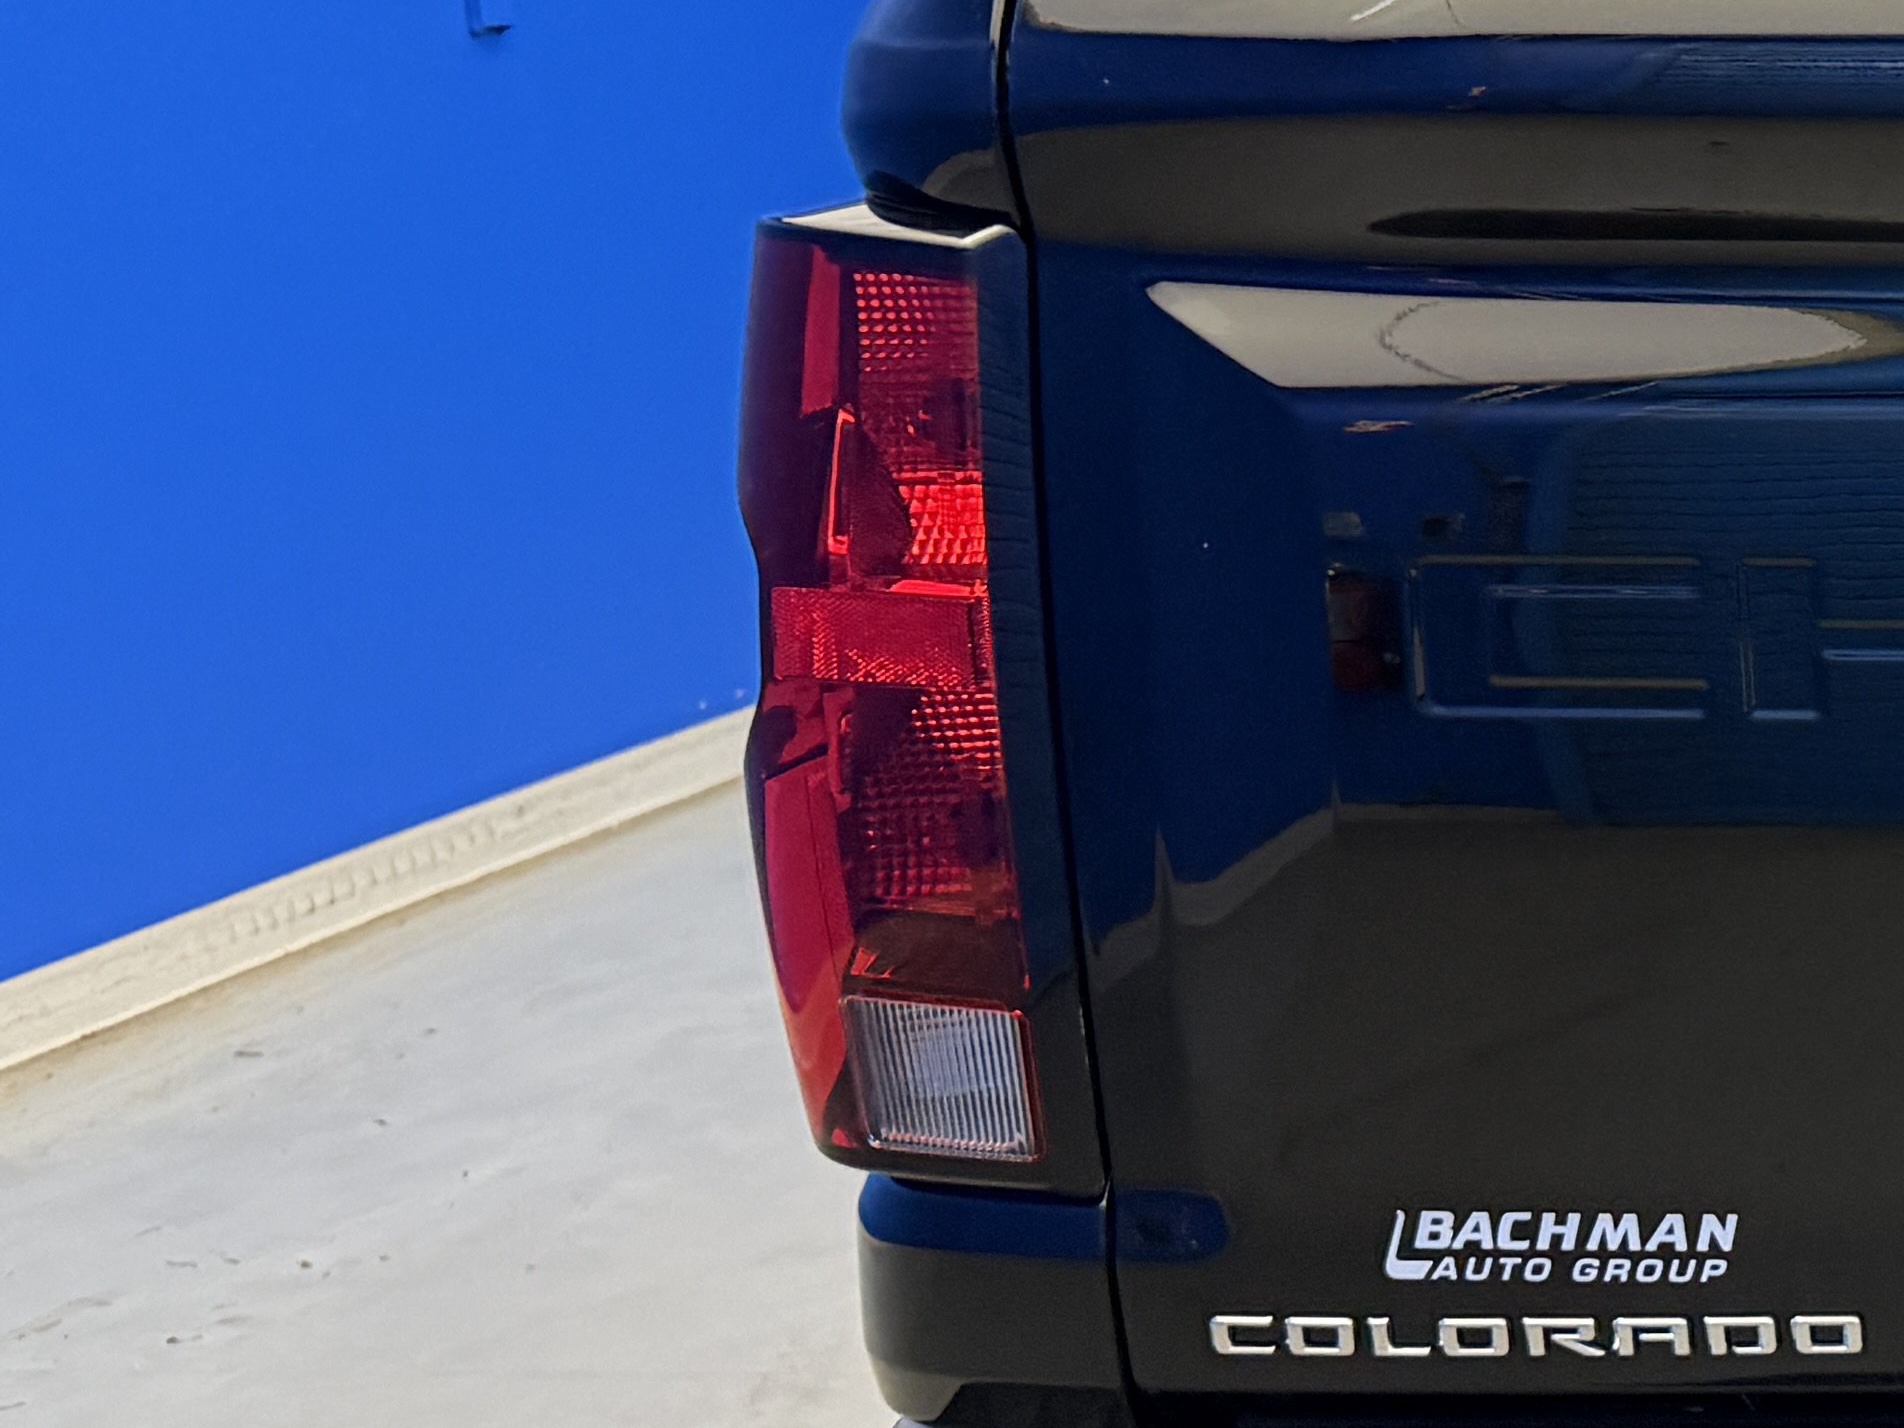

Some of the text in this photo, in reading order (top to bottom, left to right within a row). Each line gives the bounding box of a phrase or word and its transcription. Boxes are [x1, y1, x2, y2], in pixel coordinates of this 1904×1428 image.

[1414, 1209, 1739, 1254] BACHMAN
[1429, 1256, 1729, 1284] AUTO GROUP
[1209, 1314, 1865, 1358] COLORADO
